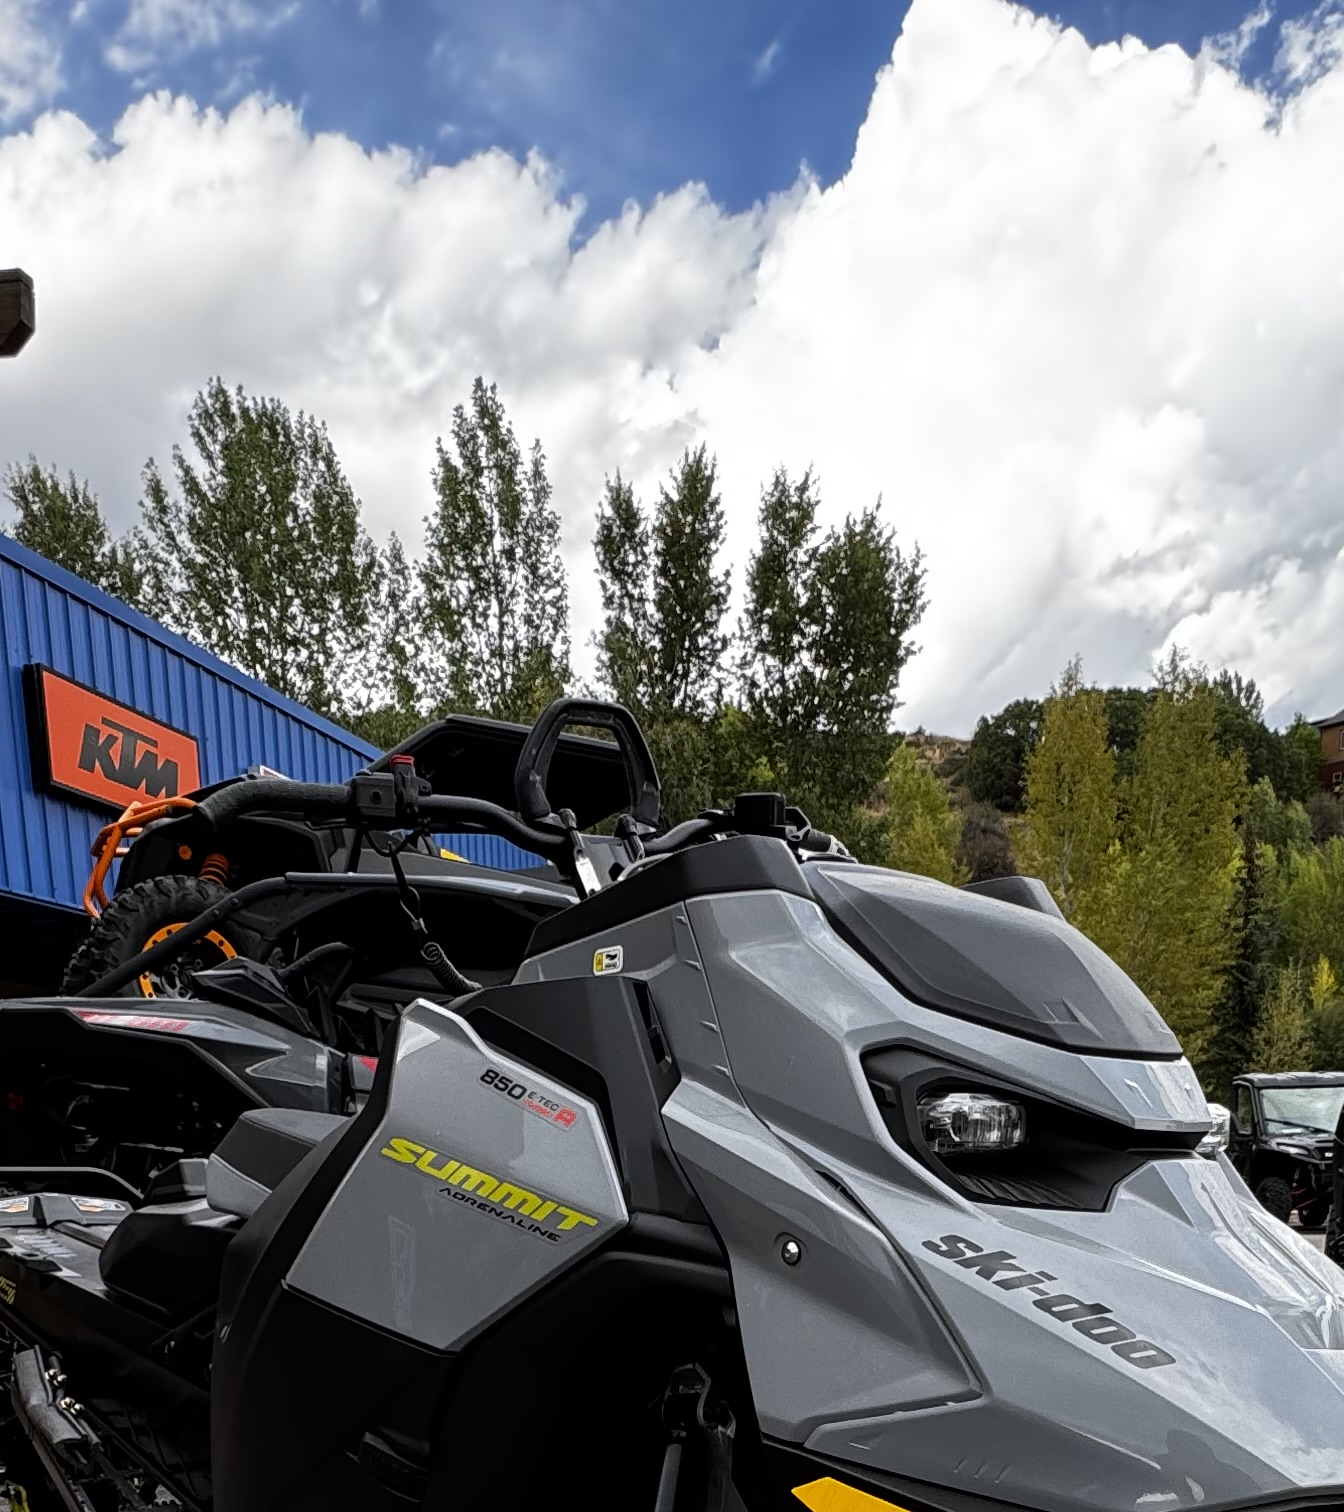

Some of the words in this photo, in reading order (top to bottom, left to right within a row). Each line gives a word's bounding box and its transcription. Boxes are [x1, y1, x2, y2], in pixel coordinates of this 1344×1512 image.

[77, 716, 179, 798] KTM
[479, 1068, 527, 1101] 850
[381, 1138, 599, 1231] SUMMIT
[439, 1187, 562, 1242] ADRENALINE
[921, 1234, 1177, 1370] ski-doo
